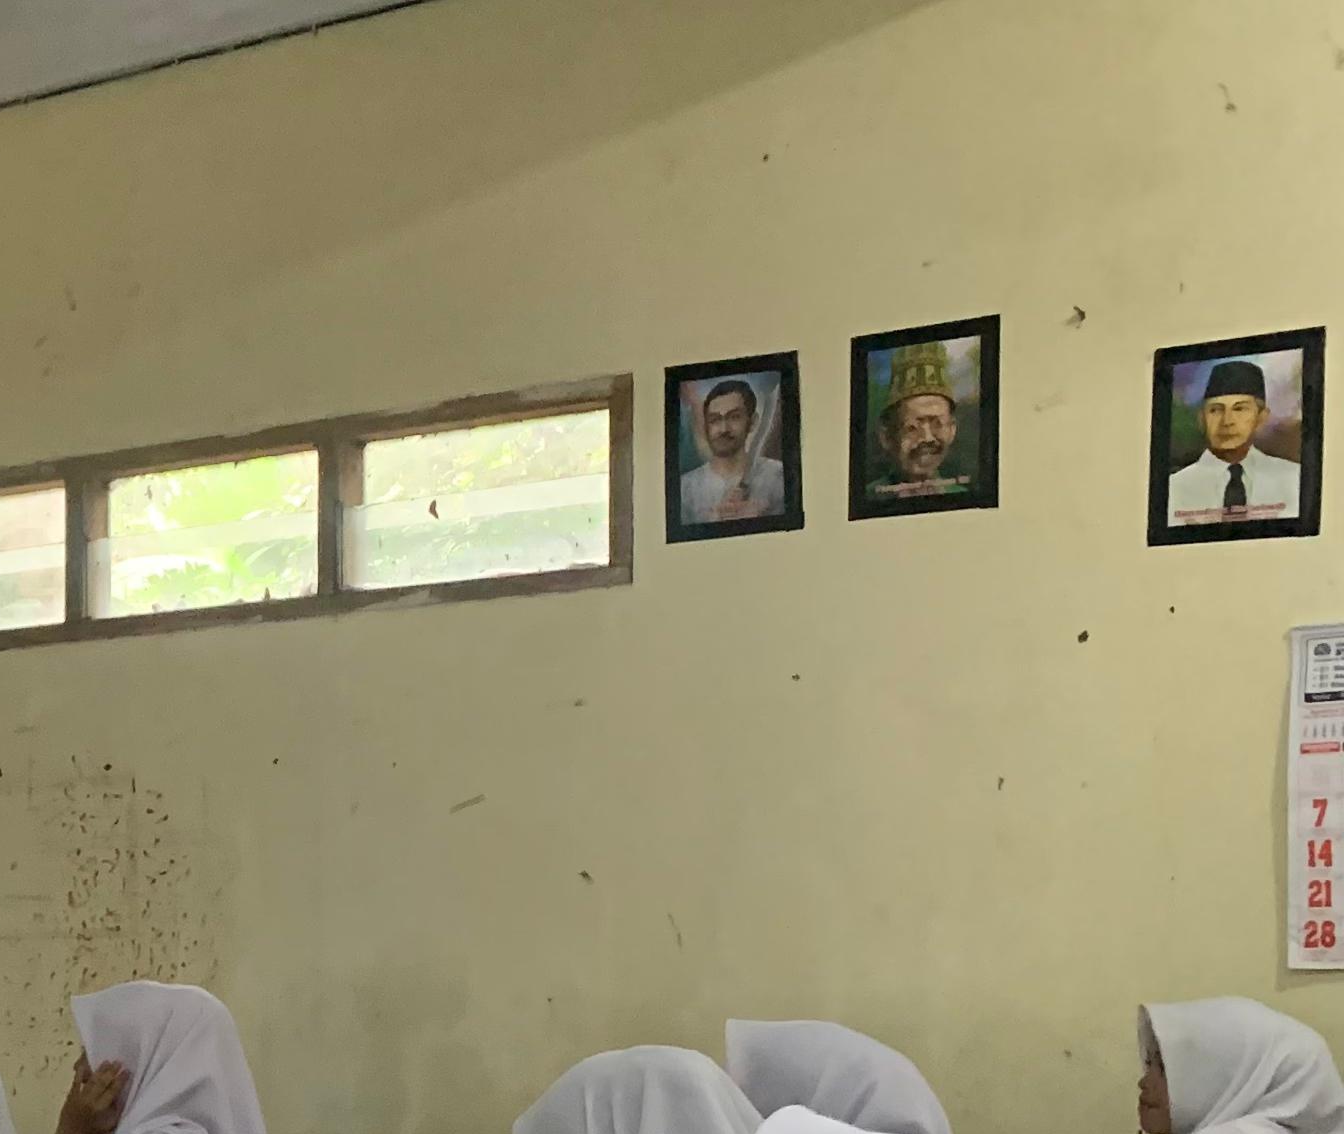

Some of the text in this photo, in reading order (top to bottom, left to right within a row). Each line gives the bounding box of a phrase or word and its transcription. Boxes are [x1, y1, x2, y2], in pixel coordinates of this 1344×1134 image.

[1312, 798, 1328, 828] 7
[1307, 839, 1333, 868] 14
[1307, 879, 1333, 908] 21
[1303, 920, 1336, 949] 28
